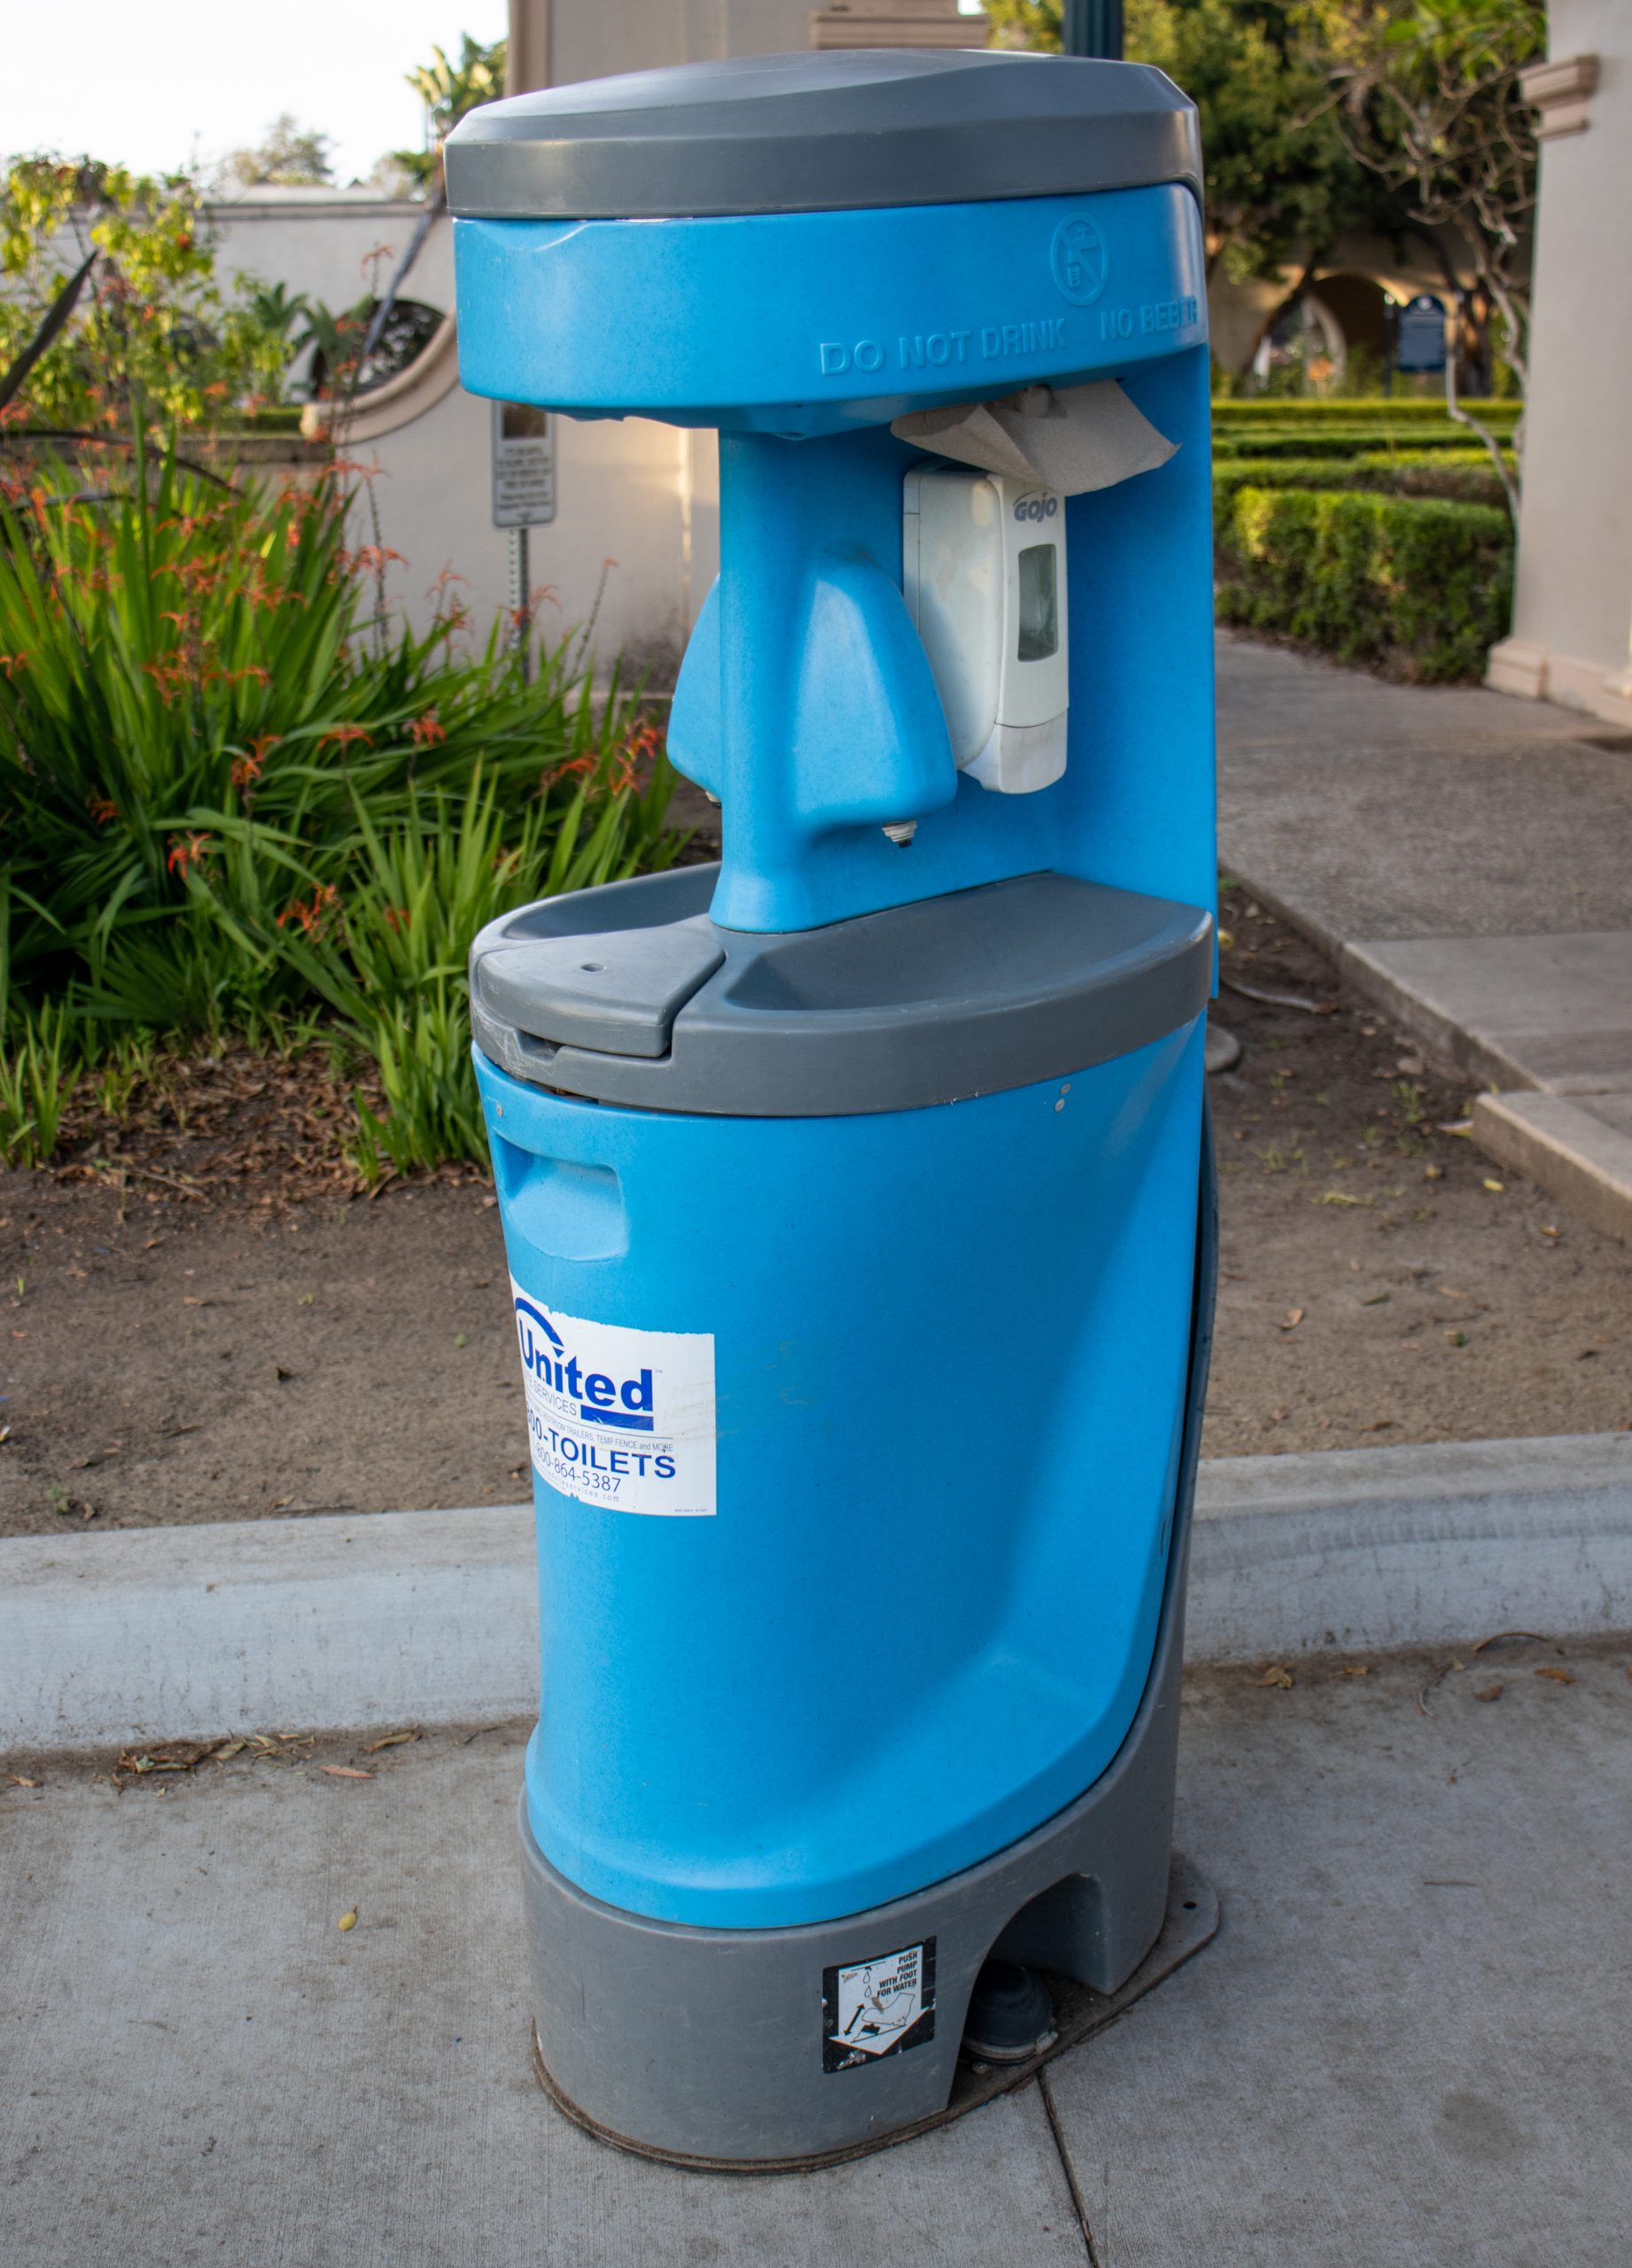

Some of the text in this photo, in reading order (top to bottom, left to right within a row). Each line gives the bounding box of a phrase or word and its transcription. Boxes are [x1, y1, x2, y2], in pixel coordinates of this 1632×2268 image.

[1100, 308, 1133, 342] NO
[820, 318, 1067, 376] DO NOT DRINK
[519, 1317, 654, 1411] United
[533, 1379, 577, 1417] SERVICES
[527, 1406, 676, 1479] 00-TOILETS
[595, 1433, 614, 1445] TEMP
[615, 1438, 637, 1449] FENCE
[639, 1441, 651, 1450] and
[652, 1443, 673, 1452] MORE
[897, 1960, 918, 1974] PUMP
[898, 1951, 918, 1964] PUSH
[877, 1978, 918, 1998] FOR WATER
[878, 1969, 918, 1989] WITH FOOT
